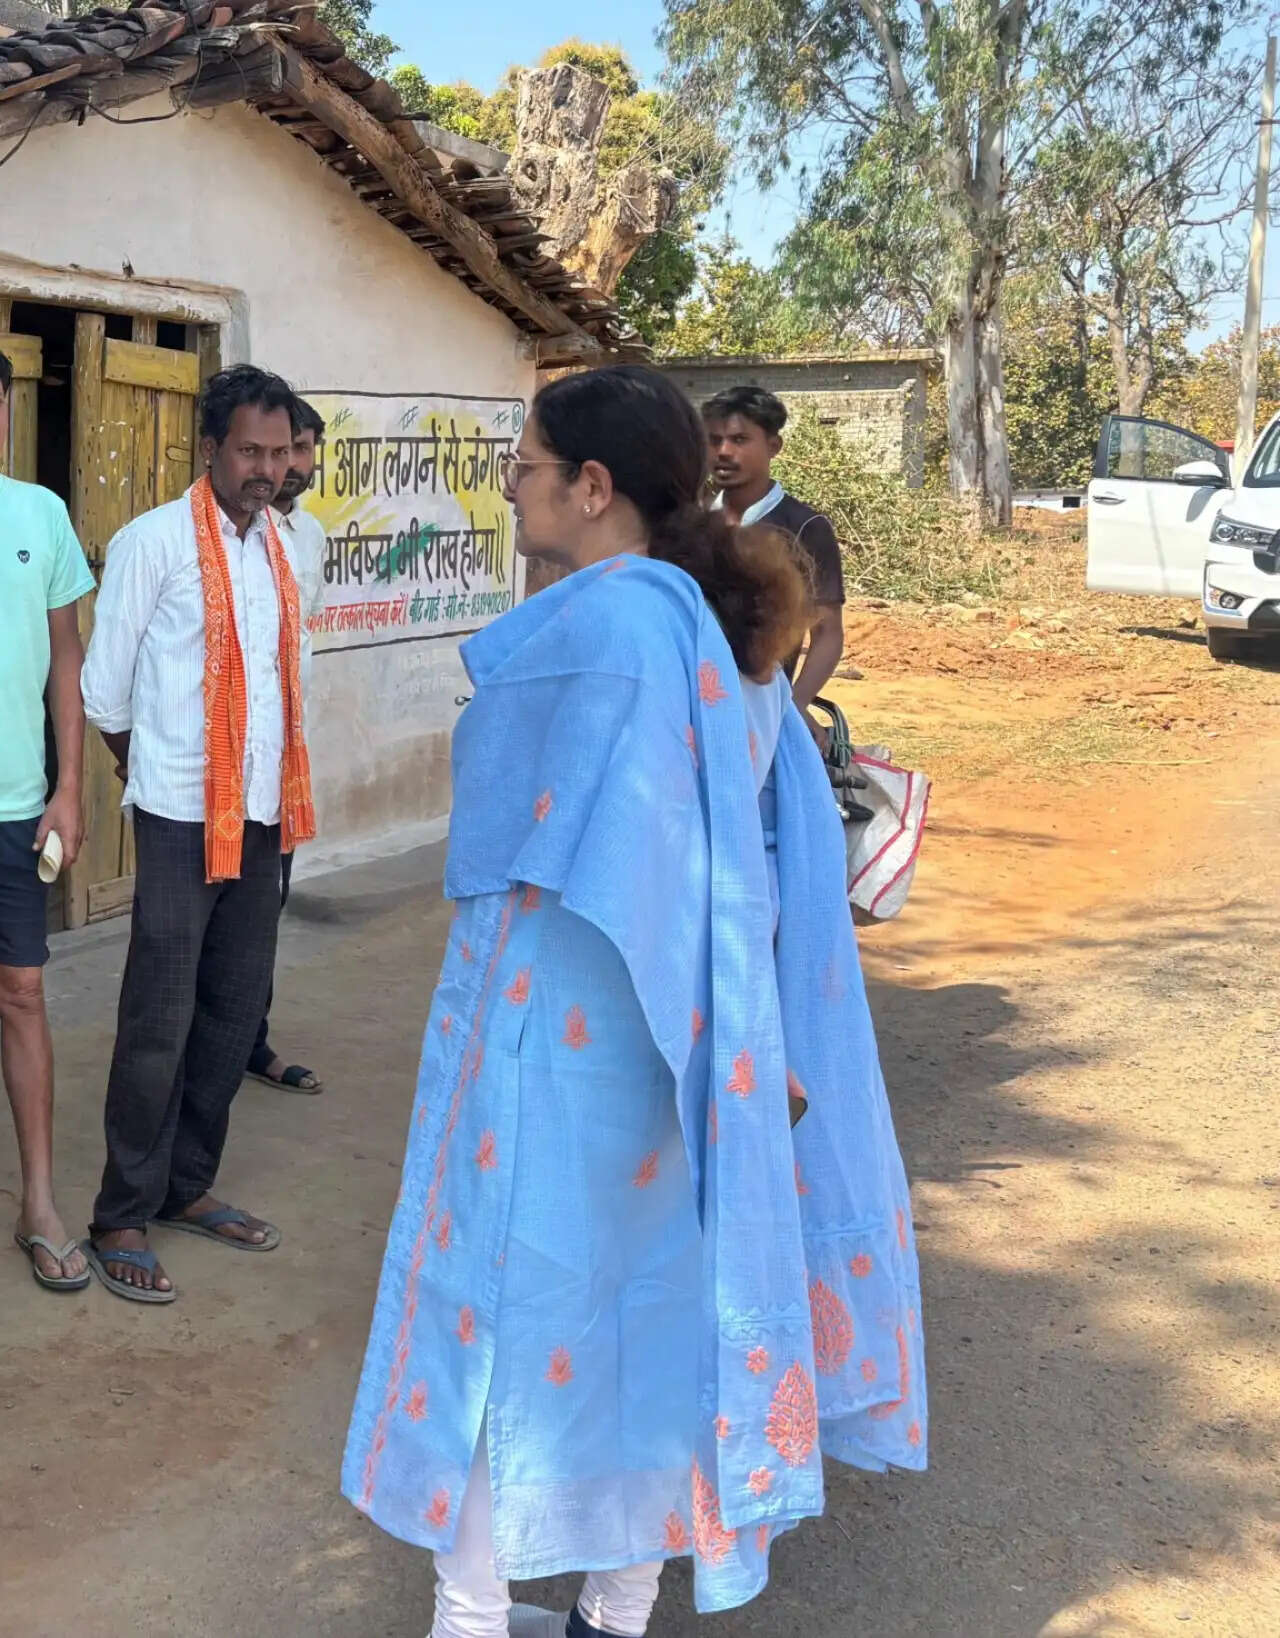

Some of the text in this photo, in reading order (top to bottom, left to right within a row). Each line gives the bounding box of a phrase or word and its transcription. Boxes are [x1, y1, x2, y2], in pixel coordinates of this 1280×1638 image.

[335, 437, 382, 497] आग
[444, 418, 461, 494] से
[323, 520, 393, 585] भविष्य
[396, 517, 420, 580] भी
[423, 529, 461, 583] राख
